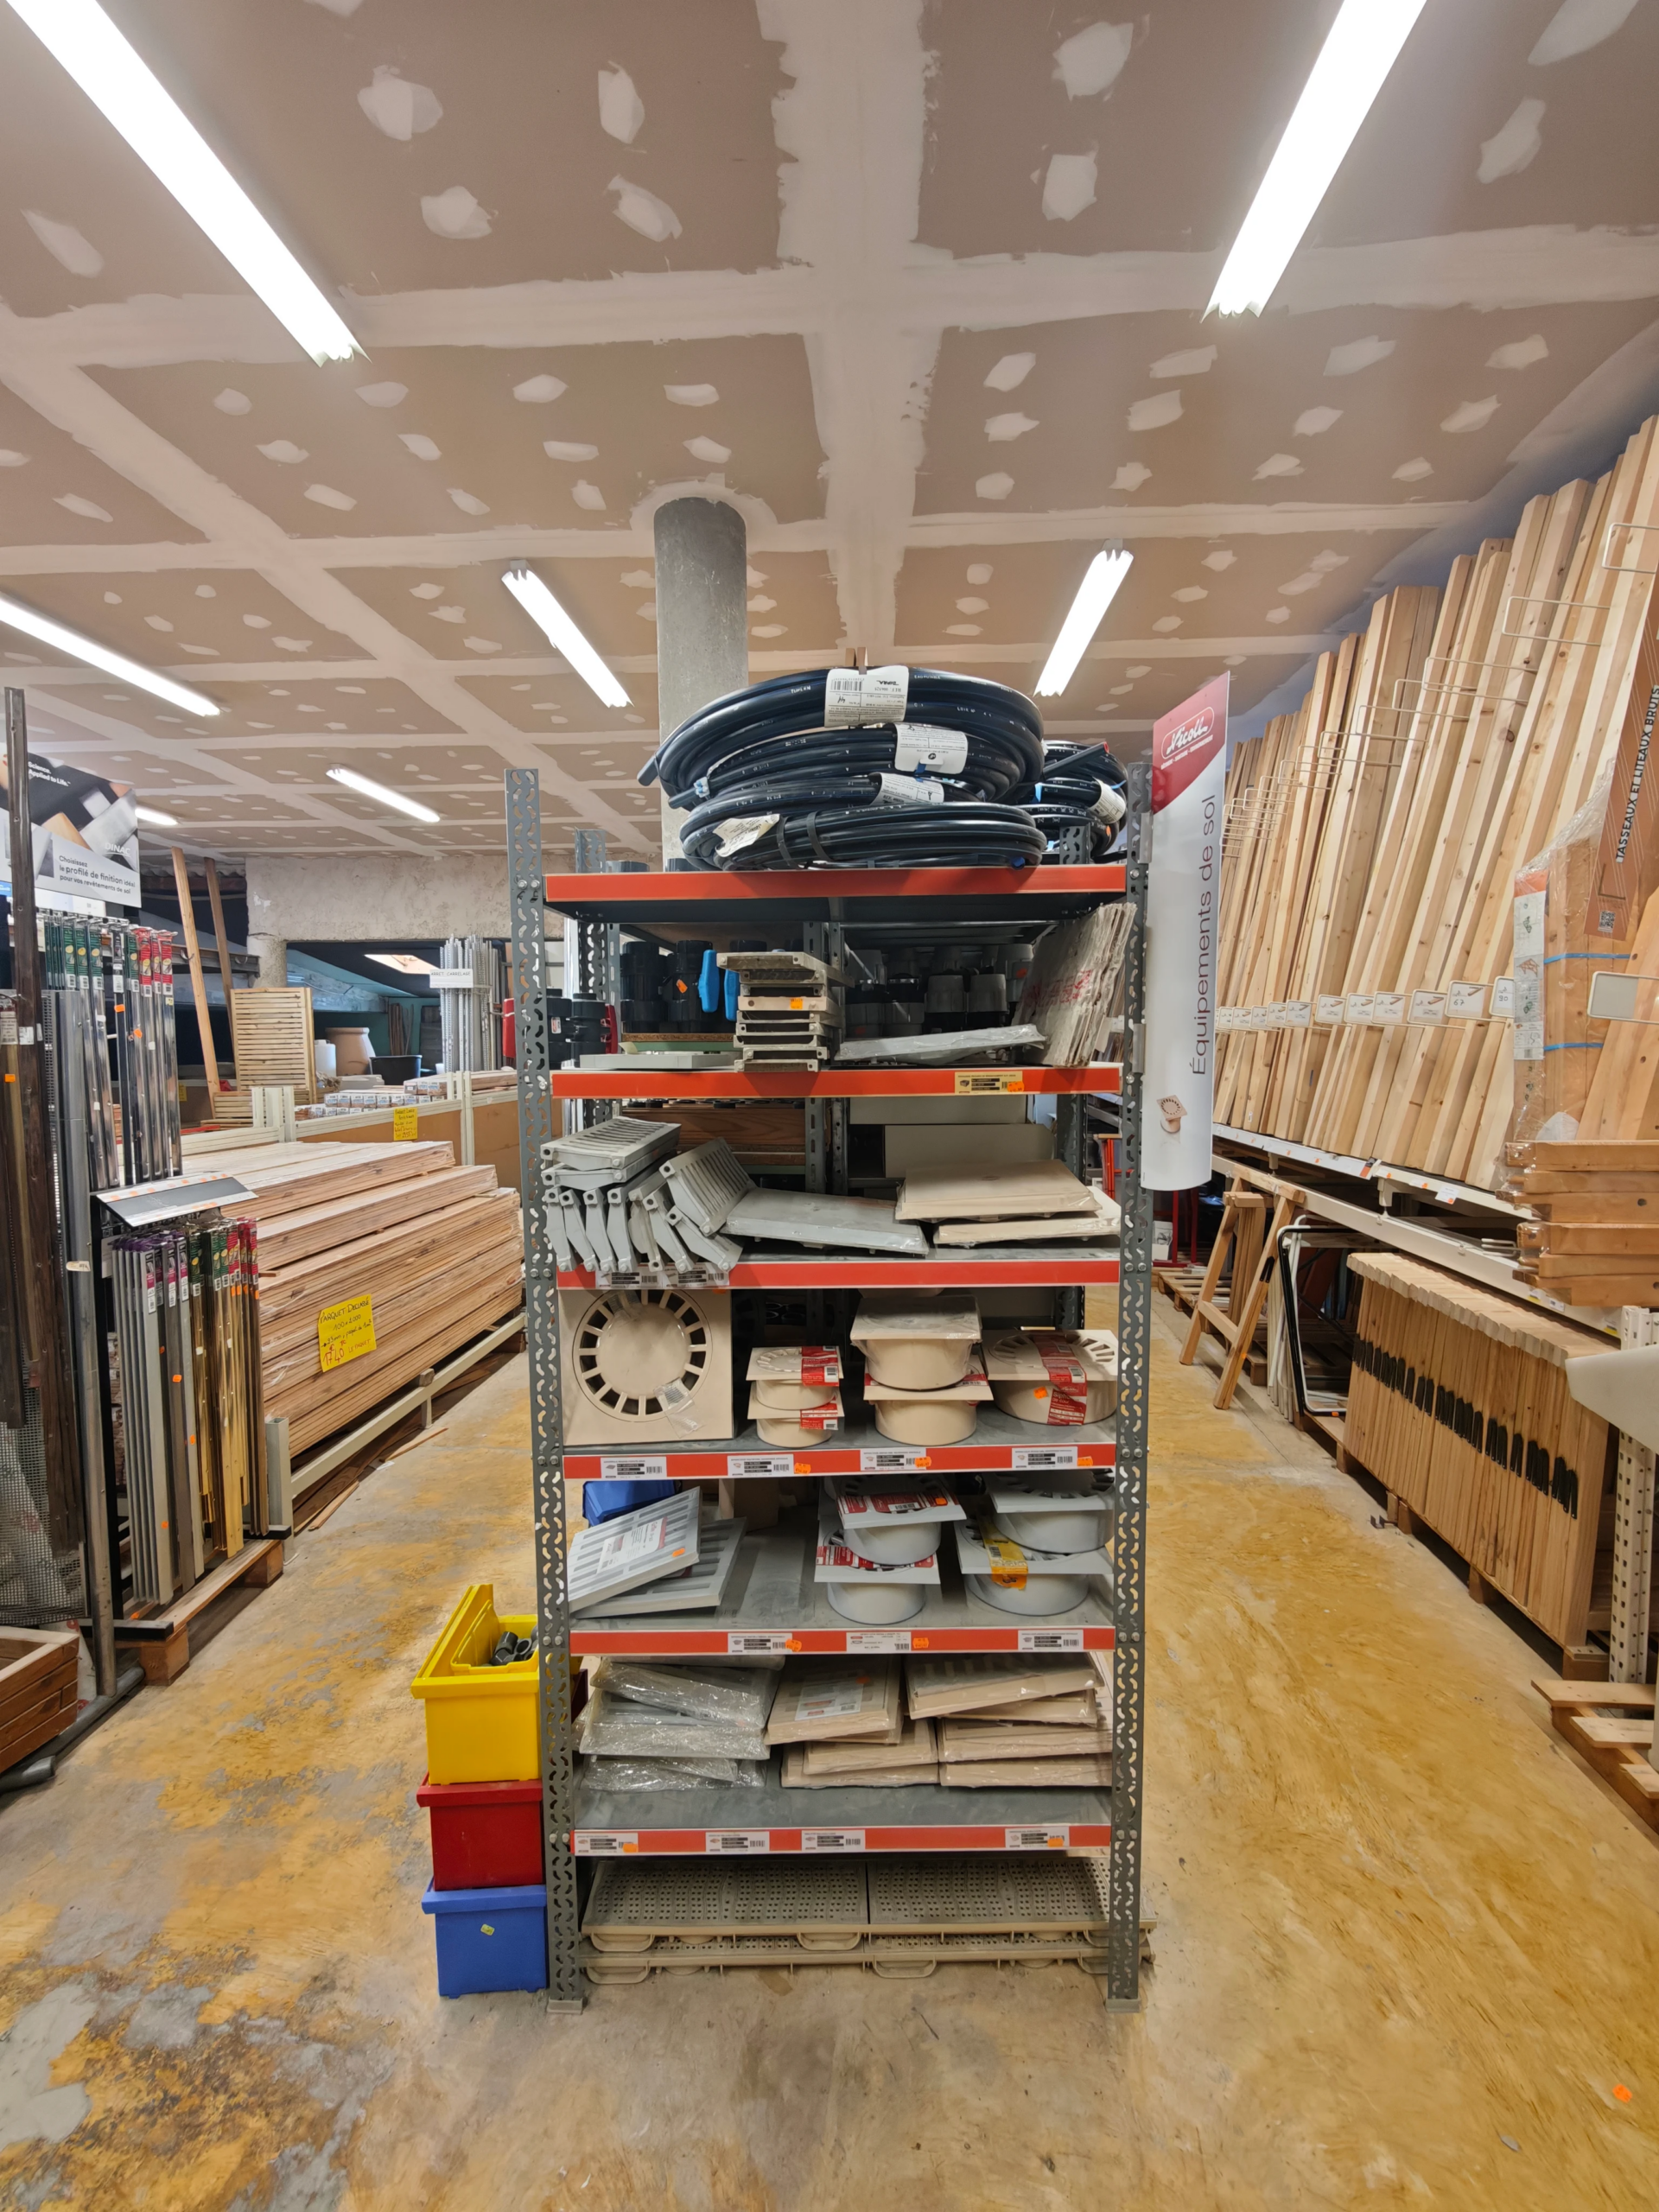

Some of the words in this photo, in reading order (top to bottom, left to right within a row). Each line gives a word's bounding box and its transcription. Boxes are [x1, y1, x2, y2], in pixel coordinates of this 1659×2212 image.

[1645, 686, 1659, 726] BRUTS
[1166, 715, 1209, 755] Nicoll
[1632, 729, 1652, 778] LITEAUX
[27, 761, 51, 774] Science.
[28, 769, 50, 781] Applied
[1630, 781, 1640, 794] ET
[1201, 795, 1216, 836] sol
[1615, 797, 1638, 860] TASSEAUX
[104, 842, 131, 855] DINAC
[59, 855, 88, 868] Choisissez
[1199, 845, 1213, 881] de
[66, 866, 89, 877] profilé
[90, 871, 99, 879] de
[100, 873, 123, 884] finition
[124, 879, 135, 888] idéal
[84, 880, 116, 891] revêtements
[1189, 891, 1211, 1075] Équipements
[320, 1307, 346, 1324] PARQUET
